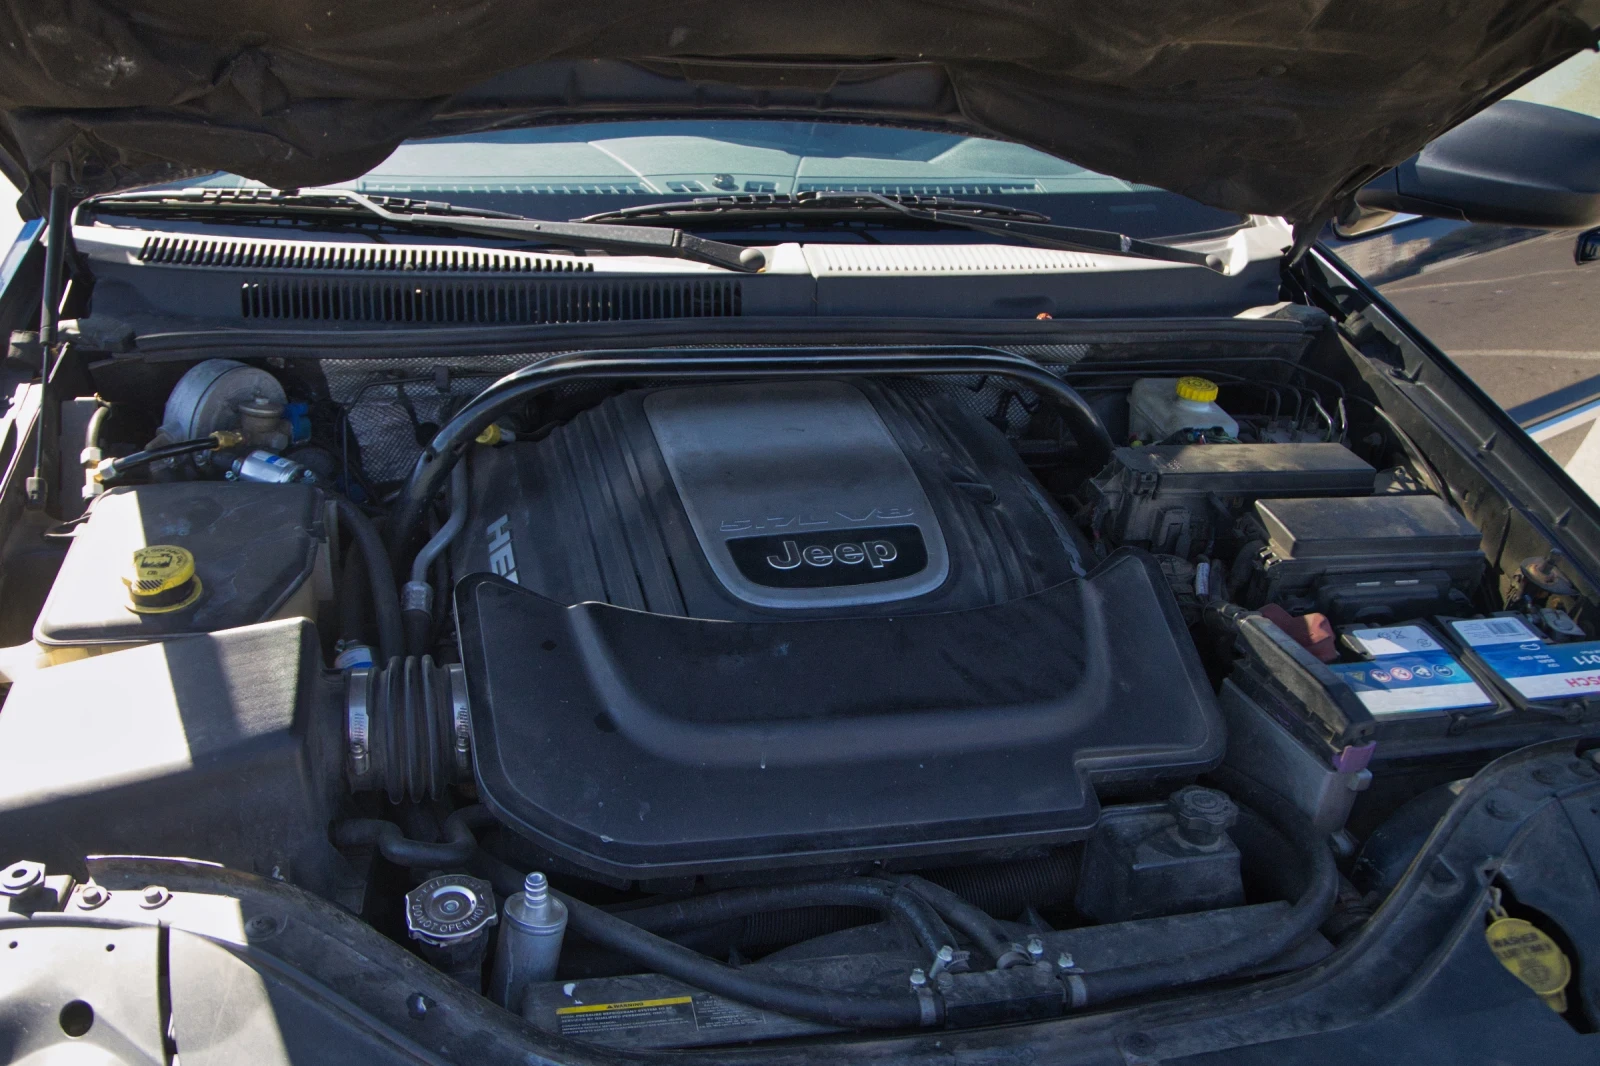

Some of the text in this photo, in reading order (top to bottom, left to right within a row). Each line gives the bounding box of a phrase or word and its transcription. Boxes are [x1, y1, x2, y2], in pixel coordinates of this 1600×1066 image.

[835, 506, 916, 523] V8
[486, 513, 520, 585] HE
[766, 539, 898, 570] Jeep
[1564, 675, 1600, 689] SCH
[439, 919, 473, 933] OPEN
[470, 904, 487, 922] HOT
